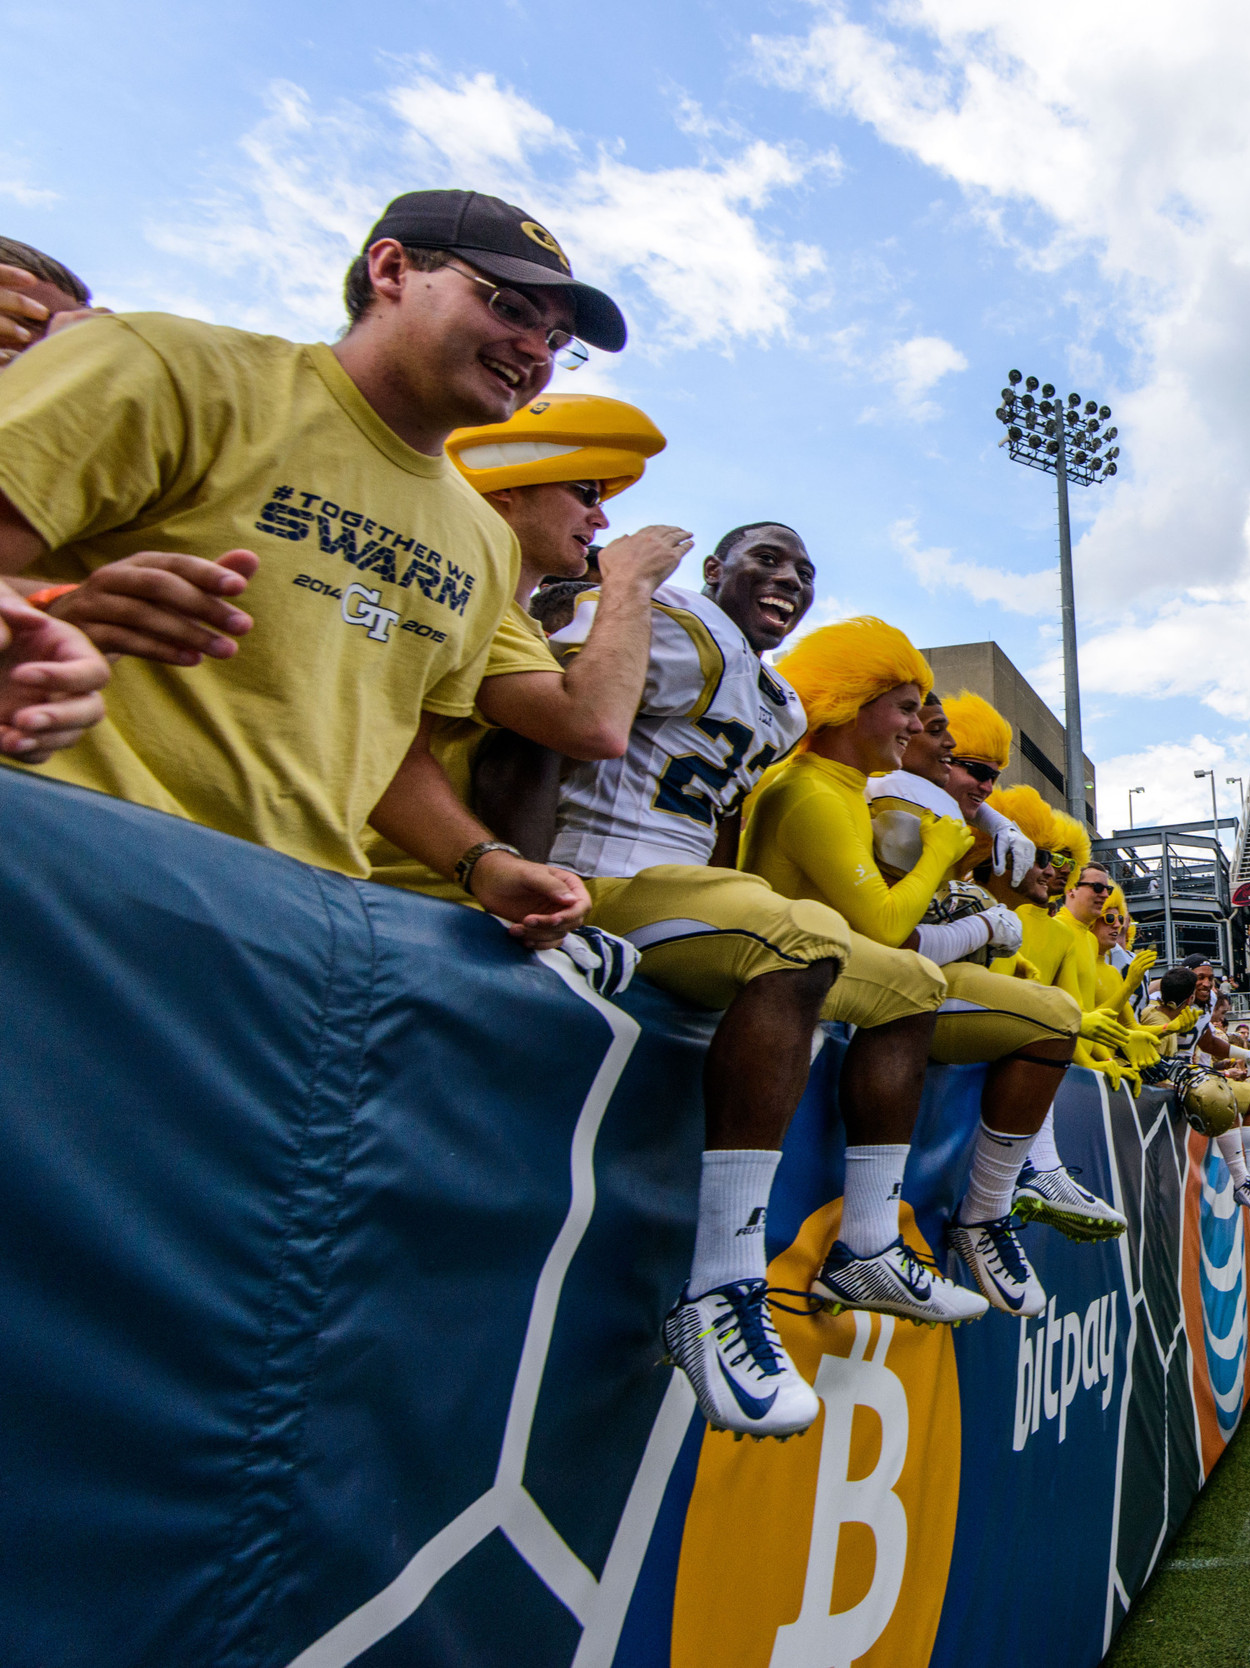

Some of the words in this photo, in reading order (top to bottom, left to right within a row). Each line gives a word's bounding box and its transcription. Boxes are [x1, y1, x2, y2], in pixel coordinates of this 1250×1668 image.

[255, 501, 472, 617] SWARM
[292, 573, 342, 600] 2014
[447, 560, 476, 590] WE
[401, 619, 448, 643] 2015
[1012, 1290, 1118, 1452] bitpay
